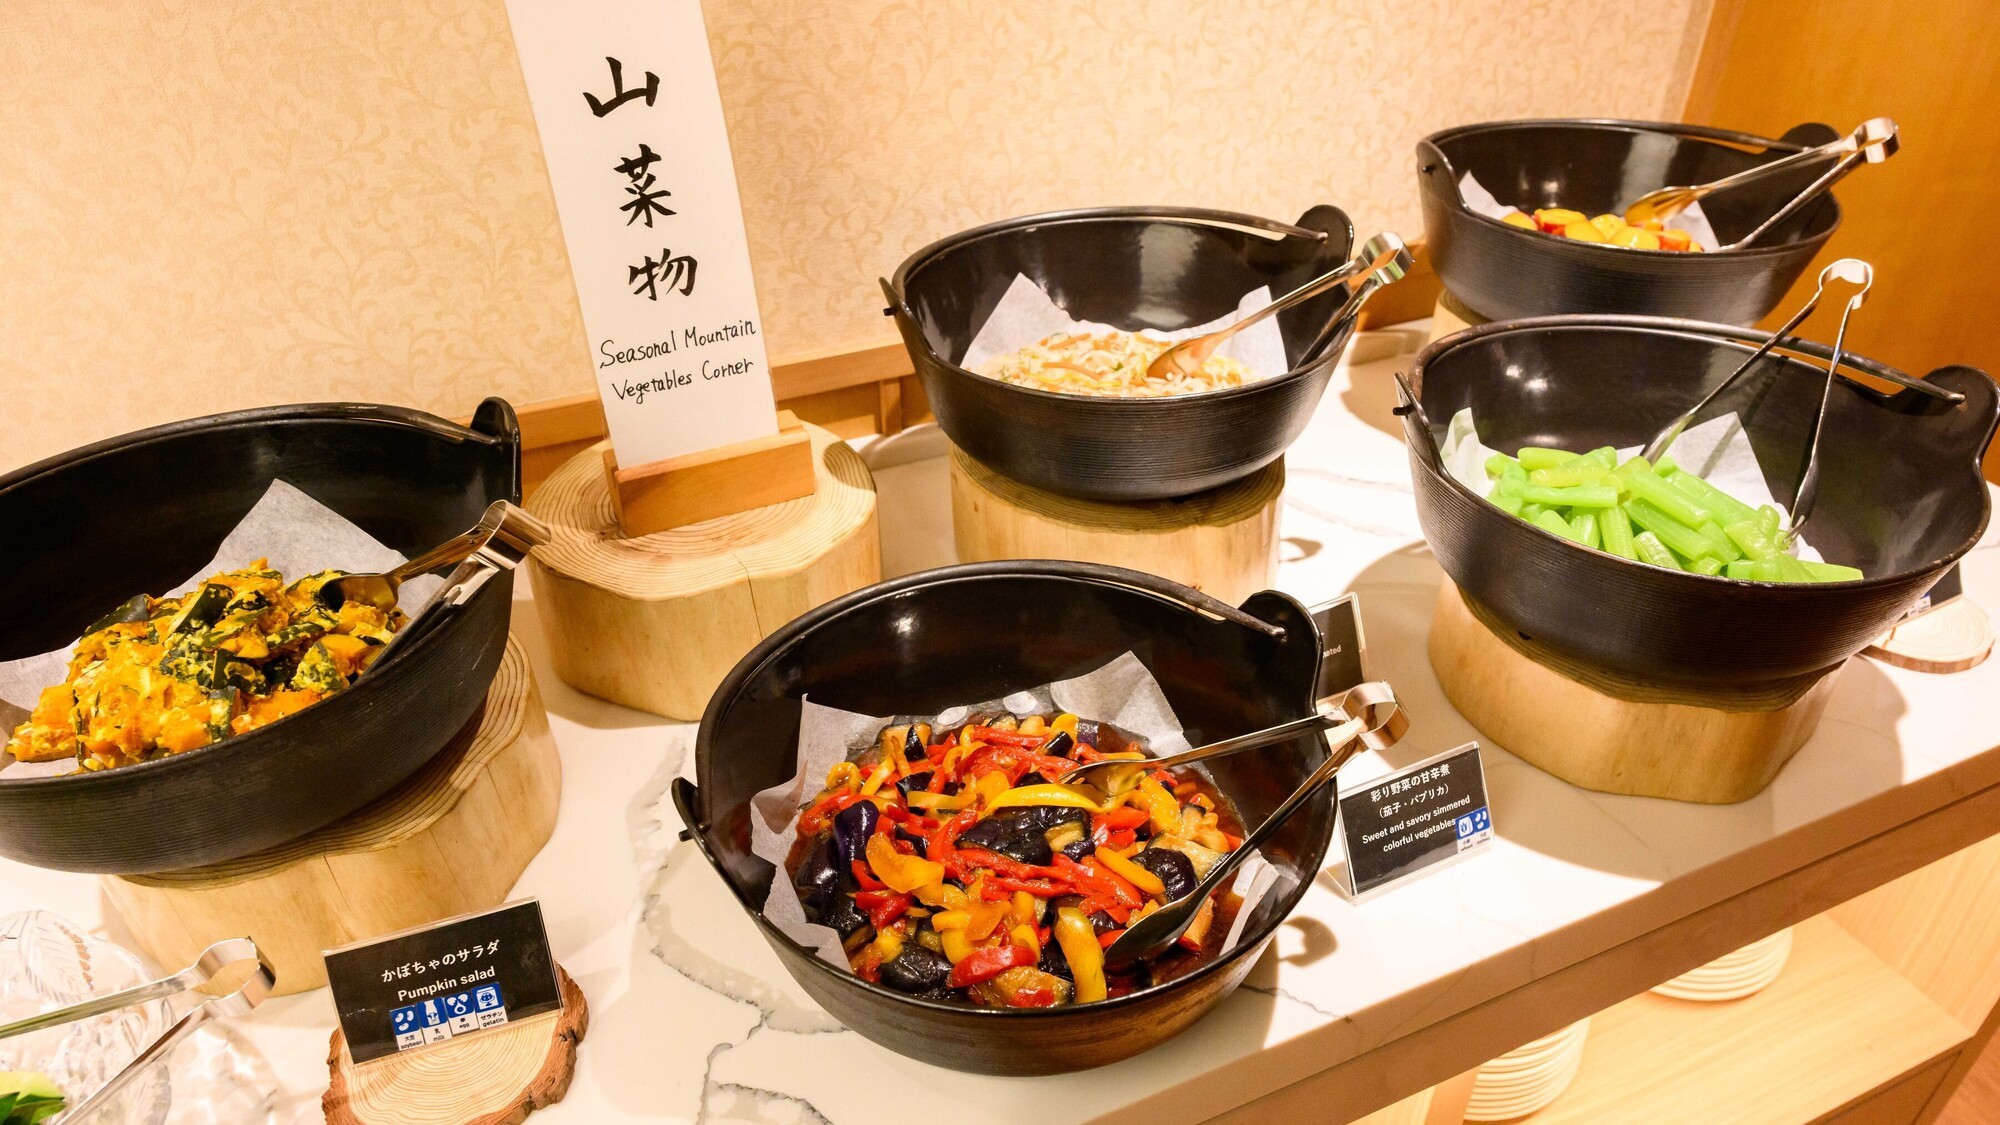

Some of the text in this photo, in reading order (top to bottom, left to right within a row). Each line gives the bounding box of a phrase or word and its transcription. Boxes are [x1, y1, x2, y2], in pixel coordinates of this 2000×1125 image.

[582, 56, 698, 301] 山菜物
[600, 319, 757, 369] Seasonal Mountain
[612, 358, 754, 404] Vegetables Corner
[1370, 764, 1451, 803] 彩り野菜の甘辛煮
[1362, 795, 1471, 844] Sweet and savory simmered
[1383, 818, 1457, 852] colorful vegetables
[381, 939, 499, 982] かぼちゃのサラダ
[398, 966, 495, 1001] Pumpkin salad
[482, 1017, 505, 1027] gelatin
